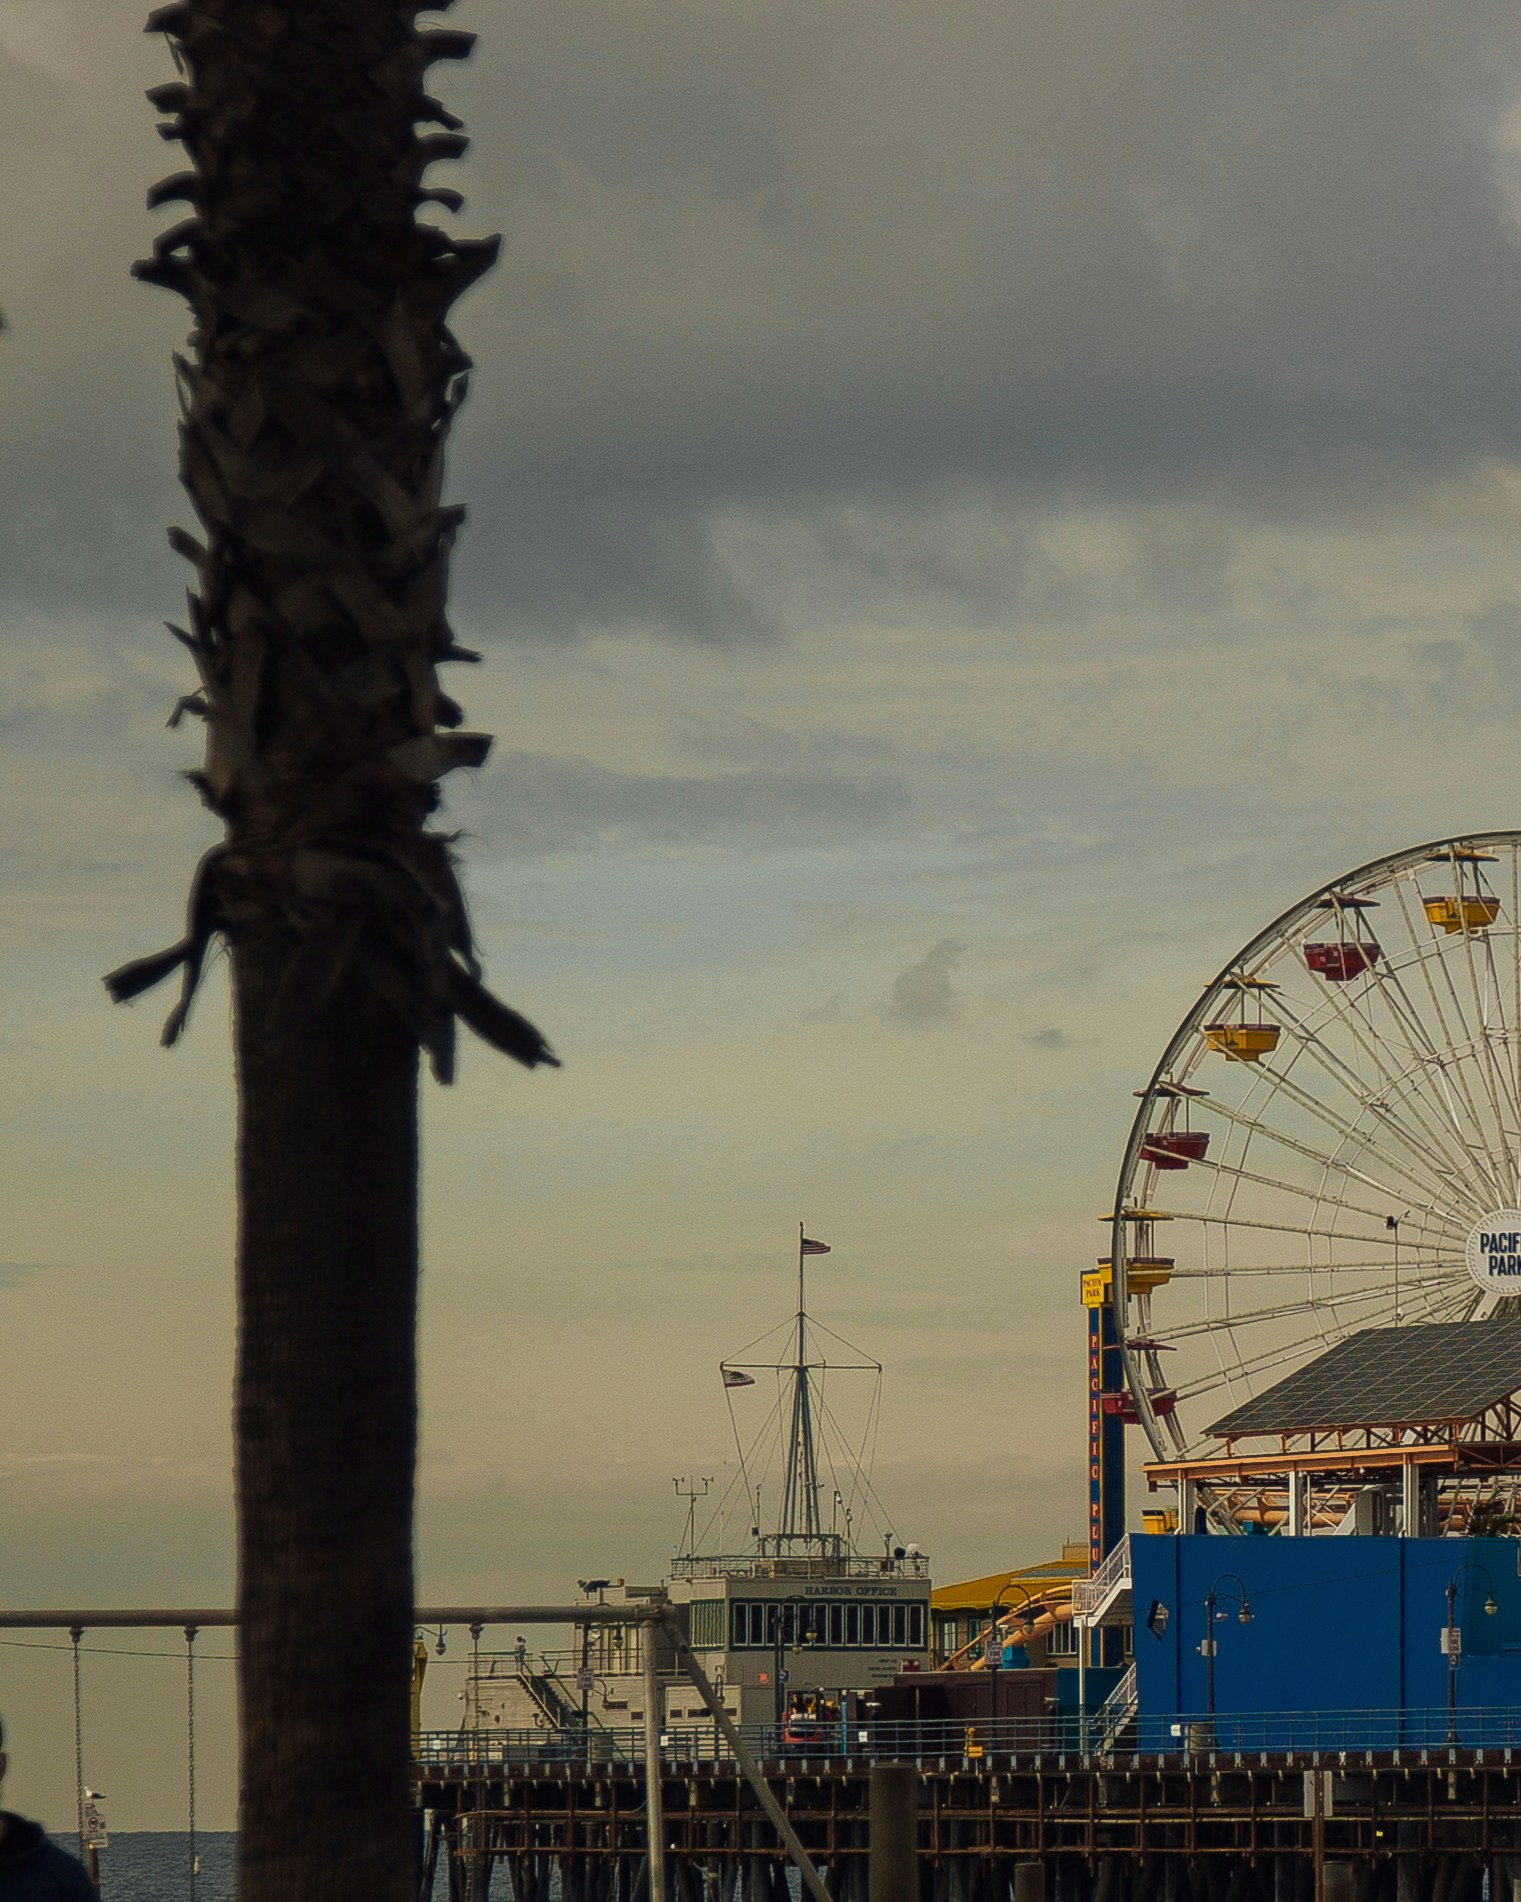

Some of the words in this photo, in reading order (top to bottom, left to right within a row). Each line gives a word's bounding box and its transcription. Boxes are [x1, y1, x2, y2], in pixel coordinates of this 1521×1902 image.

[1085, 1288, 1101, 1297] PARK
[1090, 1334, 1099, 1479] PACIFIC
[804, 1586, 852, 1596] HARBOR
[855, 1586, 897, 1597] OFFICE
